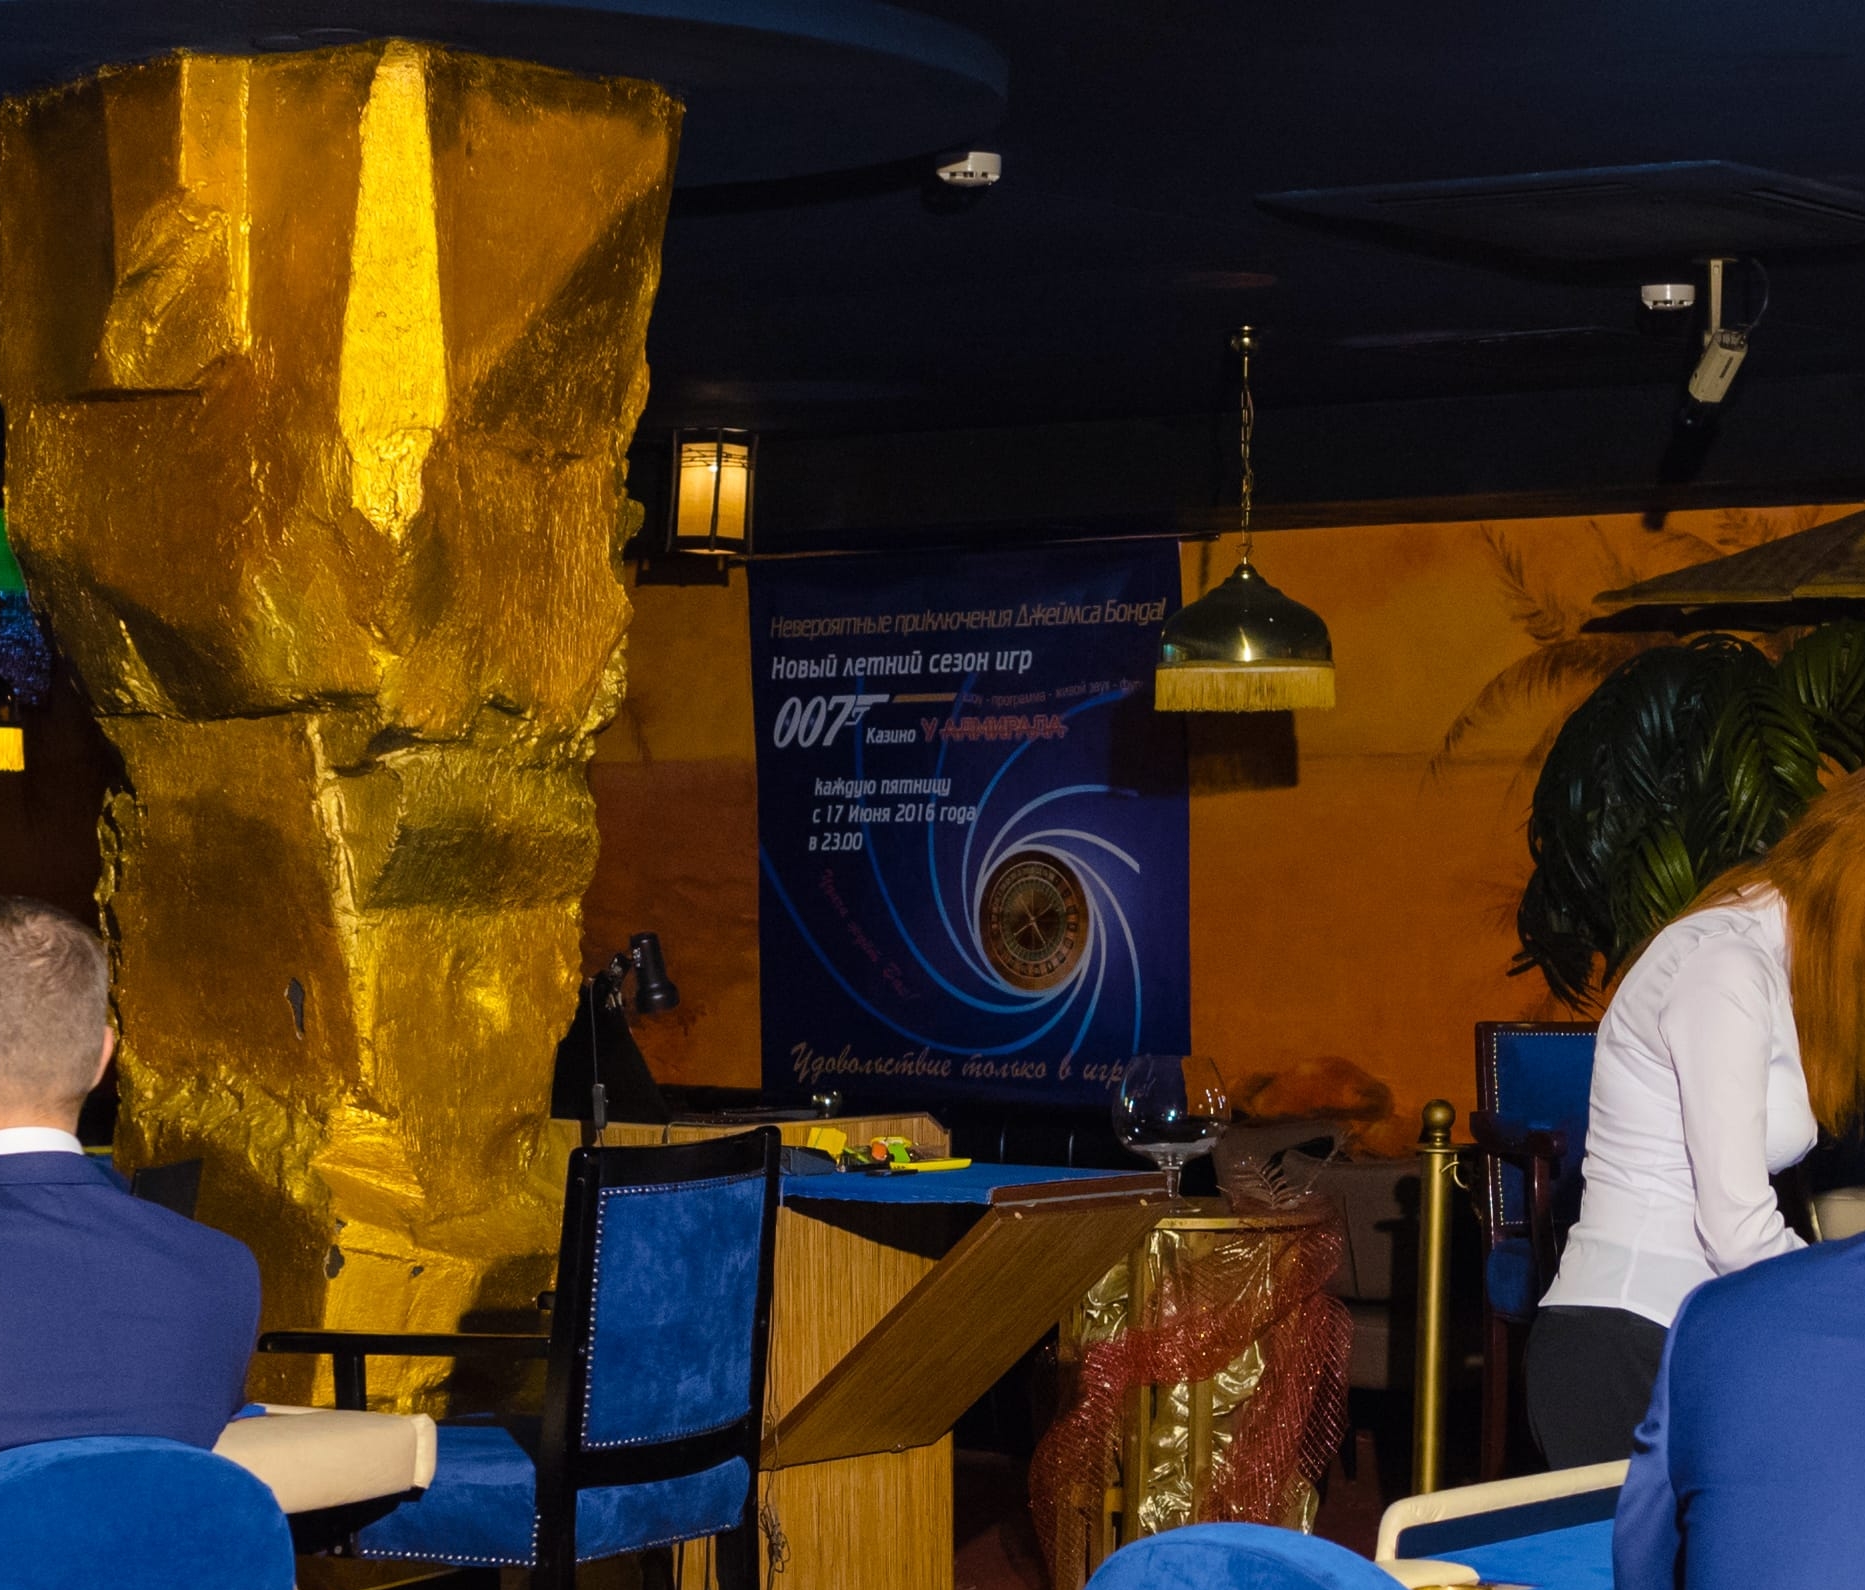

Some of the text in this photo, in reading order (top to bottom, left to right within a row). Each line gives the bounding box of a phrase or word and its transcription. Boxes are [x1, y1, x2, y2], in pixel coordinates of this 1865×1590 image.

[771, 597, 1166, 640] Невероятные приключения Джеймса Бонда!
[771, 649, 1033, 679] Новый летний сезон игр
[773, 695, 871, 748] 007
[865, 727, 916, 744] Казино
[920, 717, 938, 742] У
[814, 777, 952, 798] каждую пятницу
[812, 803, 977, 825] с 17 Июня 2016 года
[808, 836, 817, 851] в
[791, 1041, 951, 1084] Удовольствие
[961, 1052, 1047, 1080] только
[1058, 1048, 1072, 1081] в
